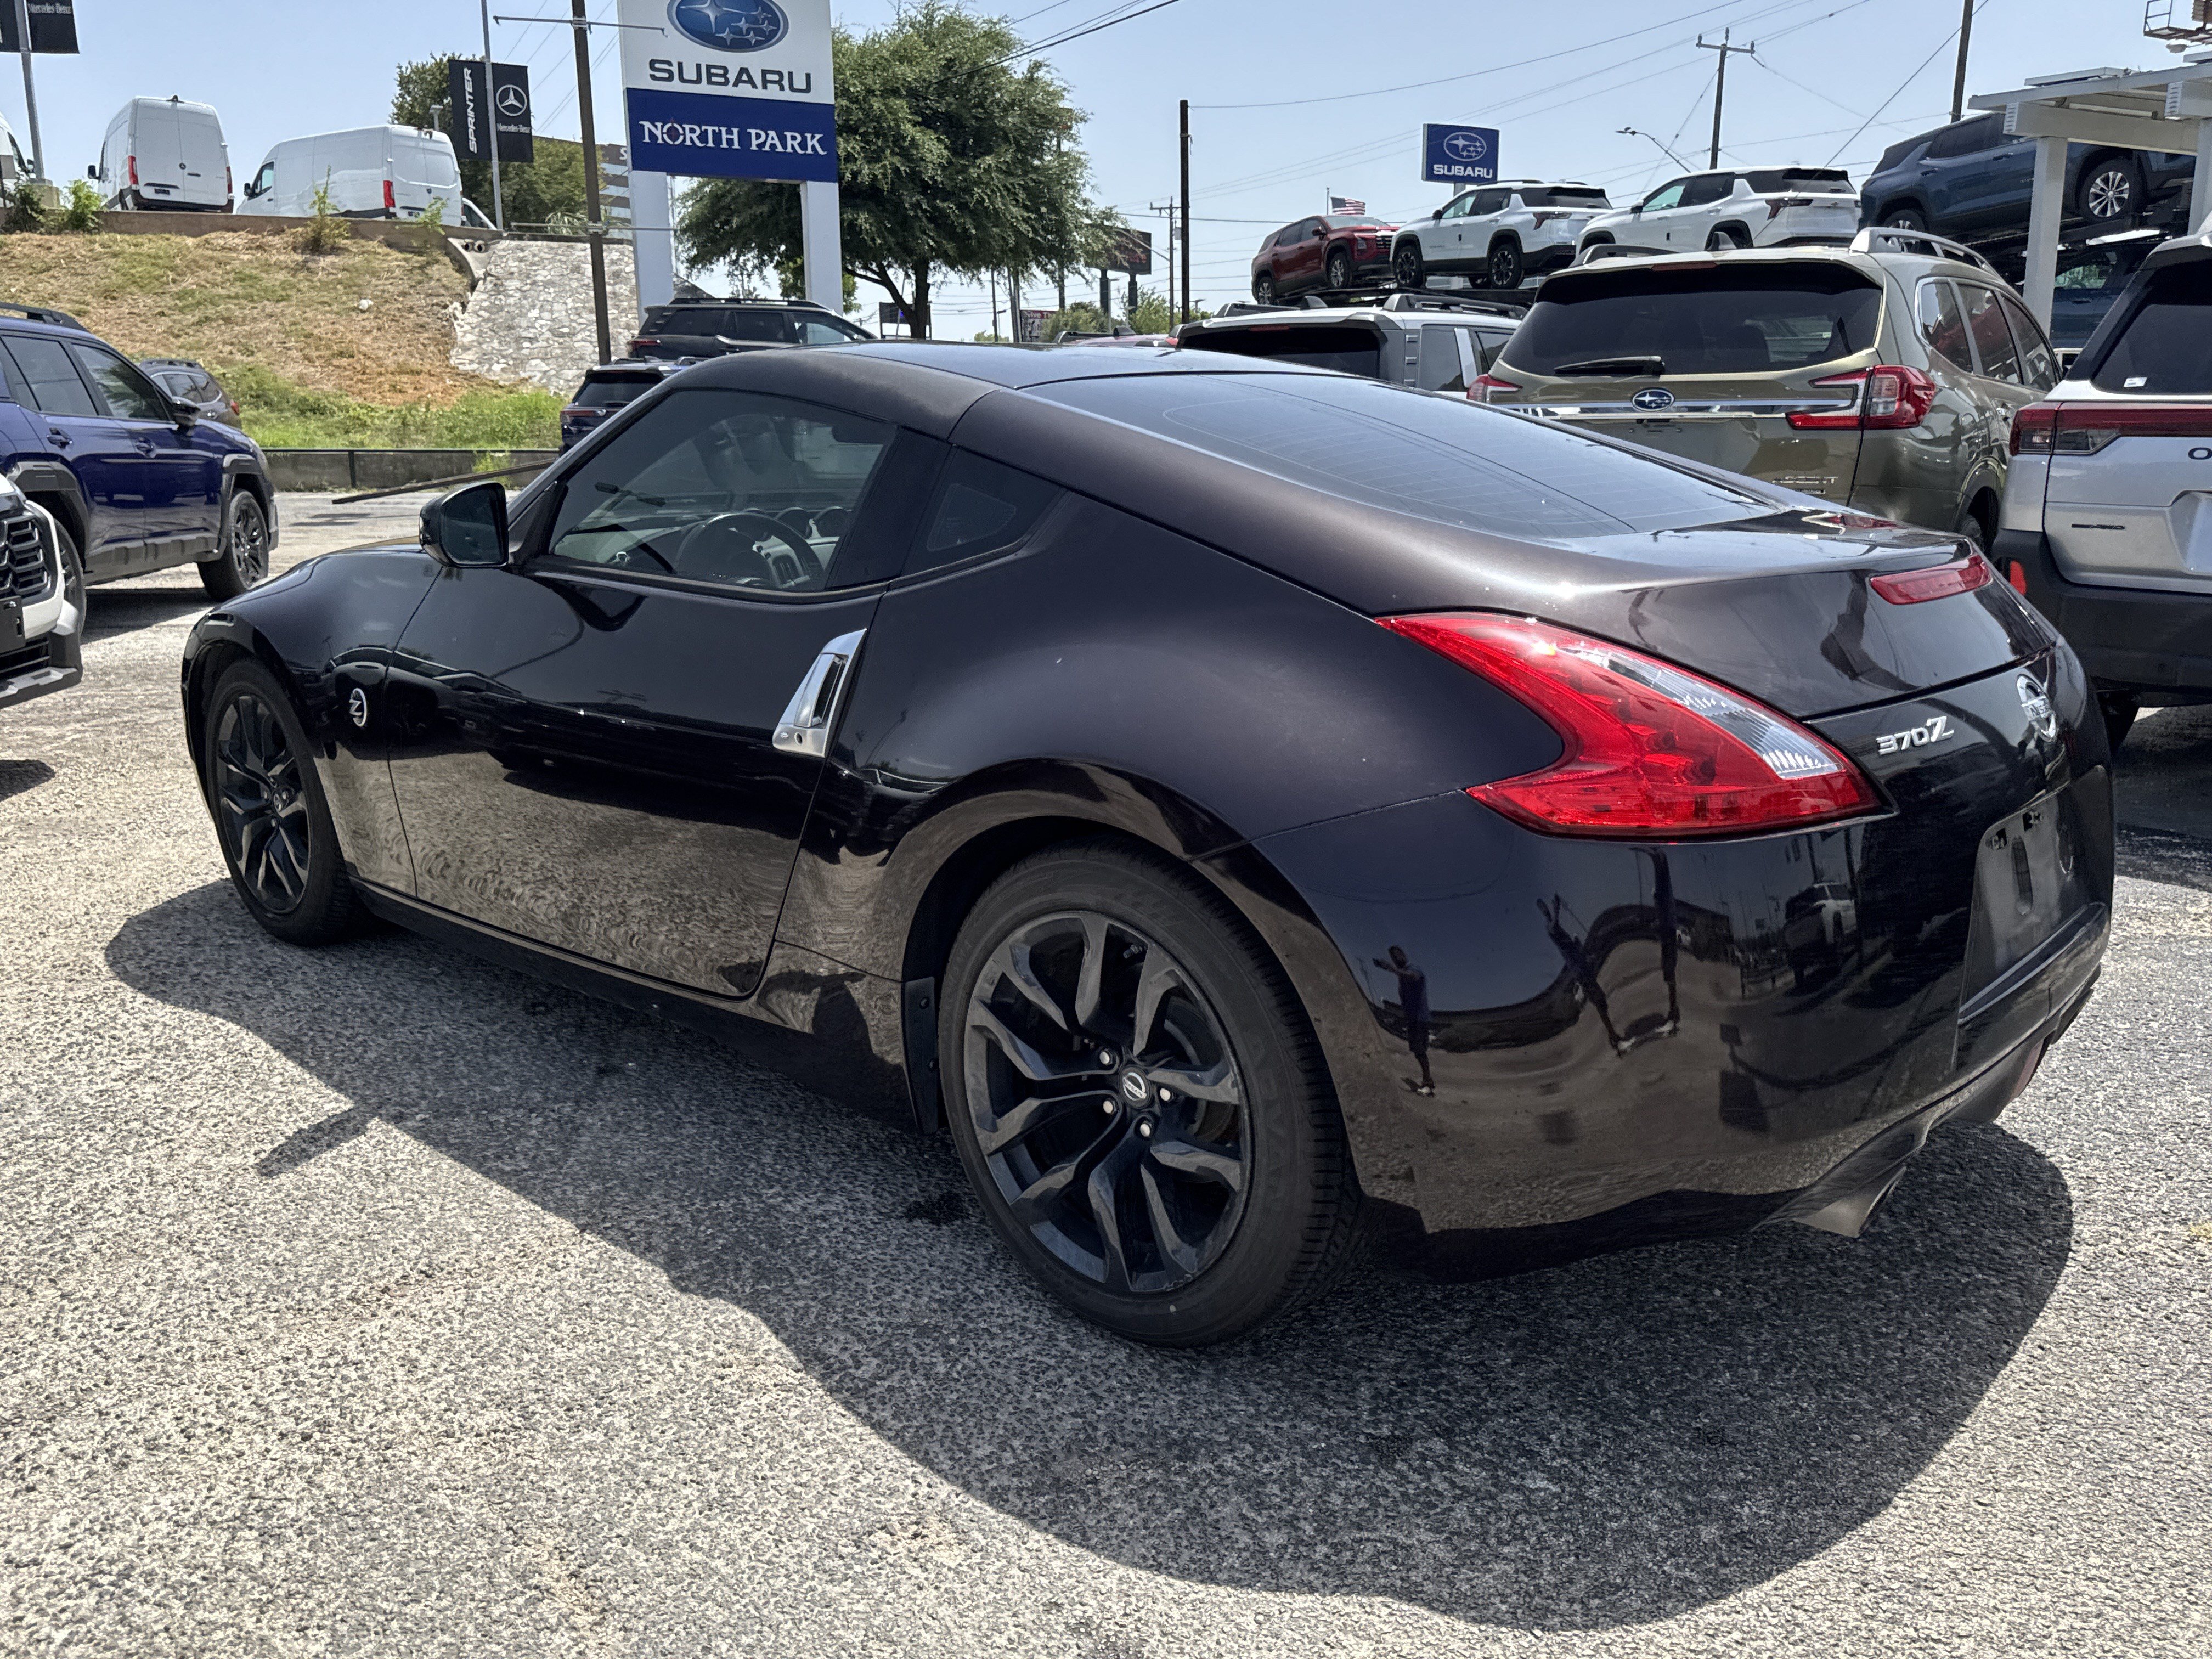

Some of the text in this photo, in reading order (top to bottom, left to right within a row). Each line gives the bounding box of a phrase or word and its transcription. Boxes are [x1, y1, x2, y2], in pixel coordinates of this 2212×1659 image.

[648, 59, 811, 93] SUBARU
[464, 67, 477, 154] SPRINTER
[639, 120, 827, 155] NORTH PARK
[1433, 164, 1493, 178] SUBARU
[1876, 715, 1954, 755] 370Z
